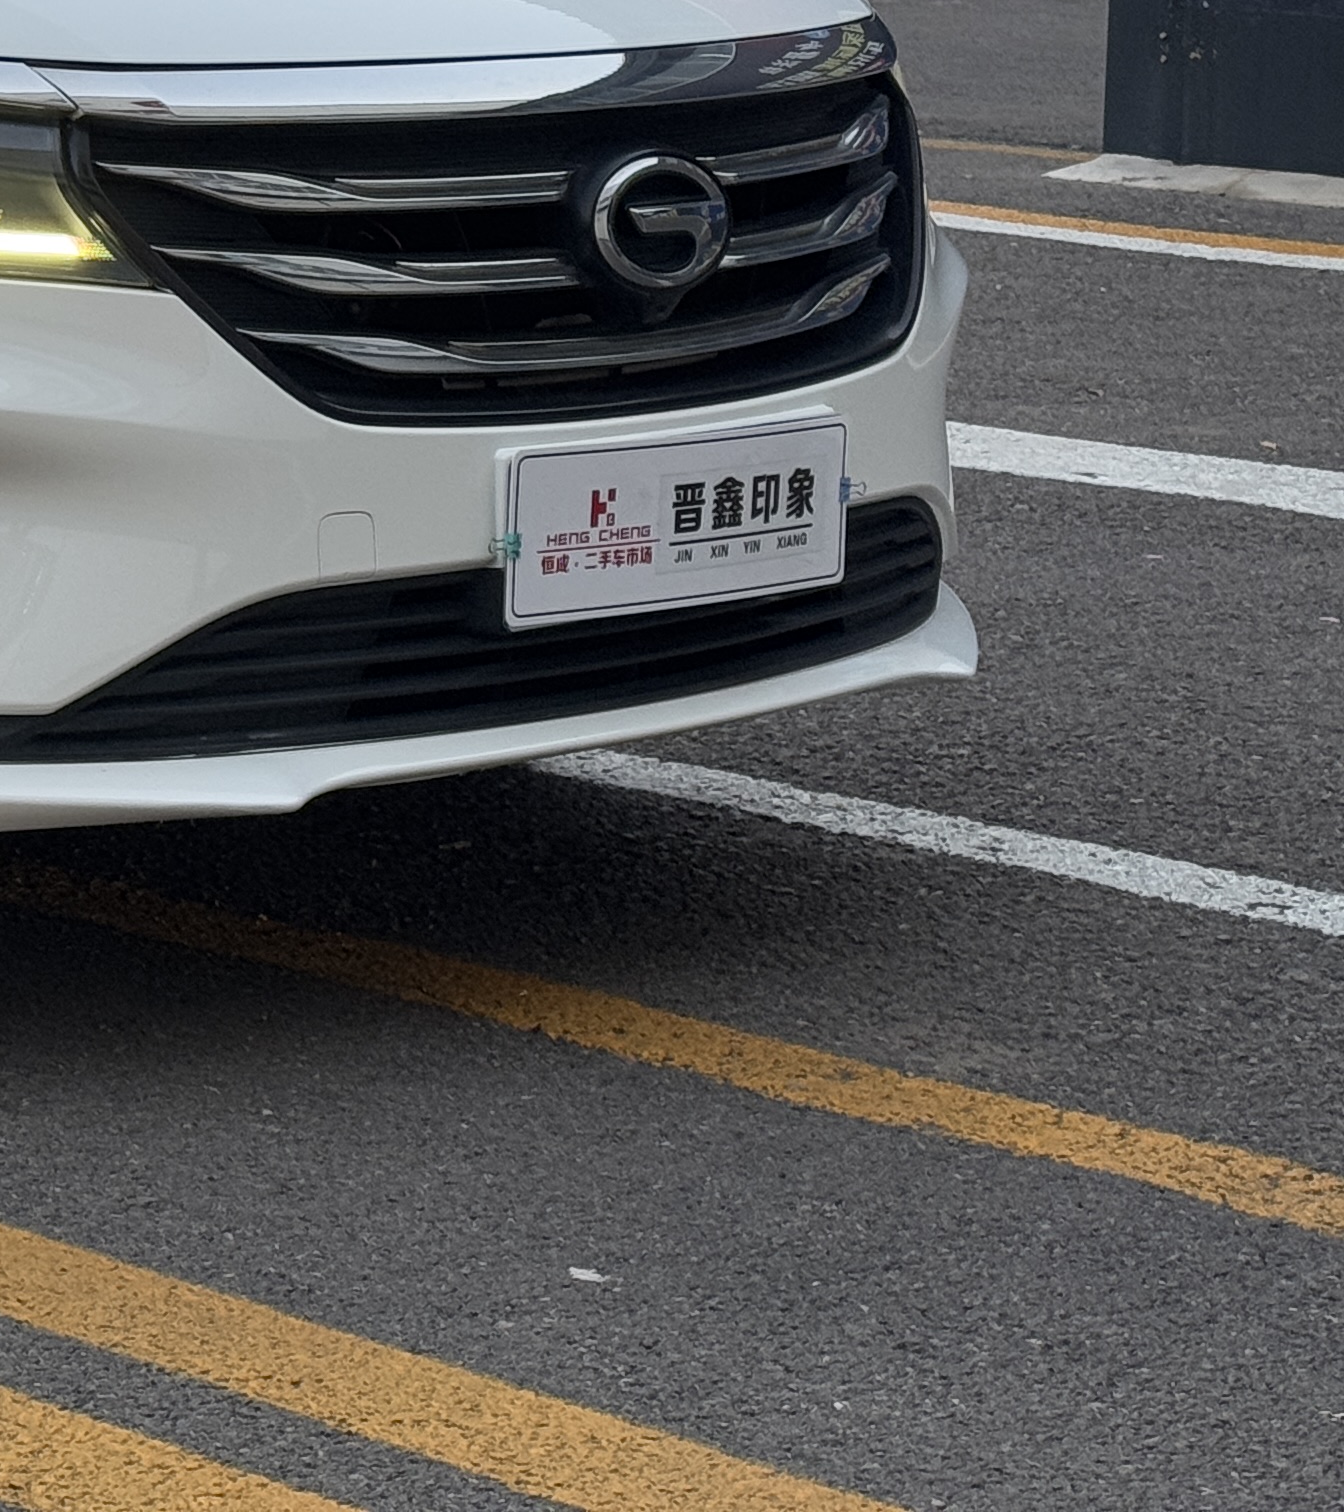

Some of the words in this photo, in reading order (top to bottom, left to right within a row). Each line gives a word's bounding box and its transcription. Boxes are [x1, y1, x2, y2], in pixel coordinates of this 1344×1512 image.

[672, 468, 815, 534] 晋鑫印象
[674, 548, 693, 564] JIN
[710, 543, 730, 560] XIN
[744, 539, 762, 555] YIN
[776, 532, 808, 550] XIANG
